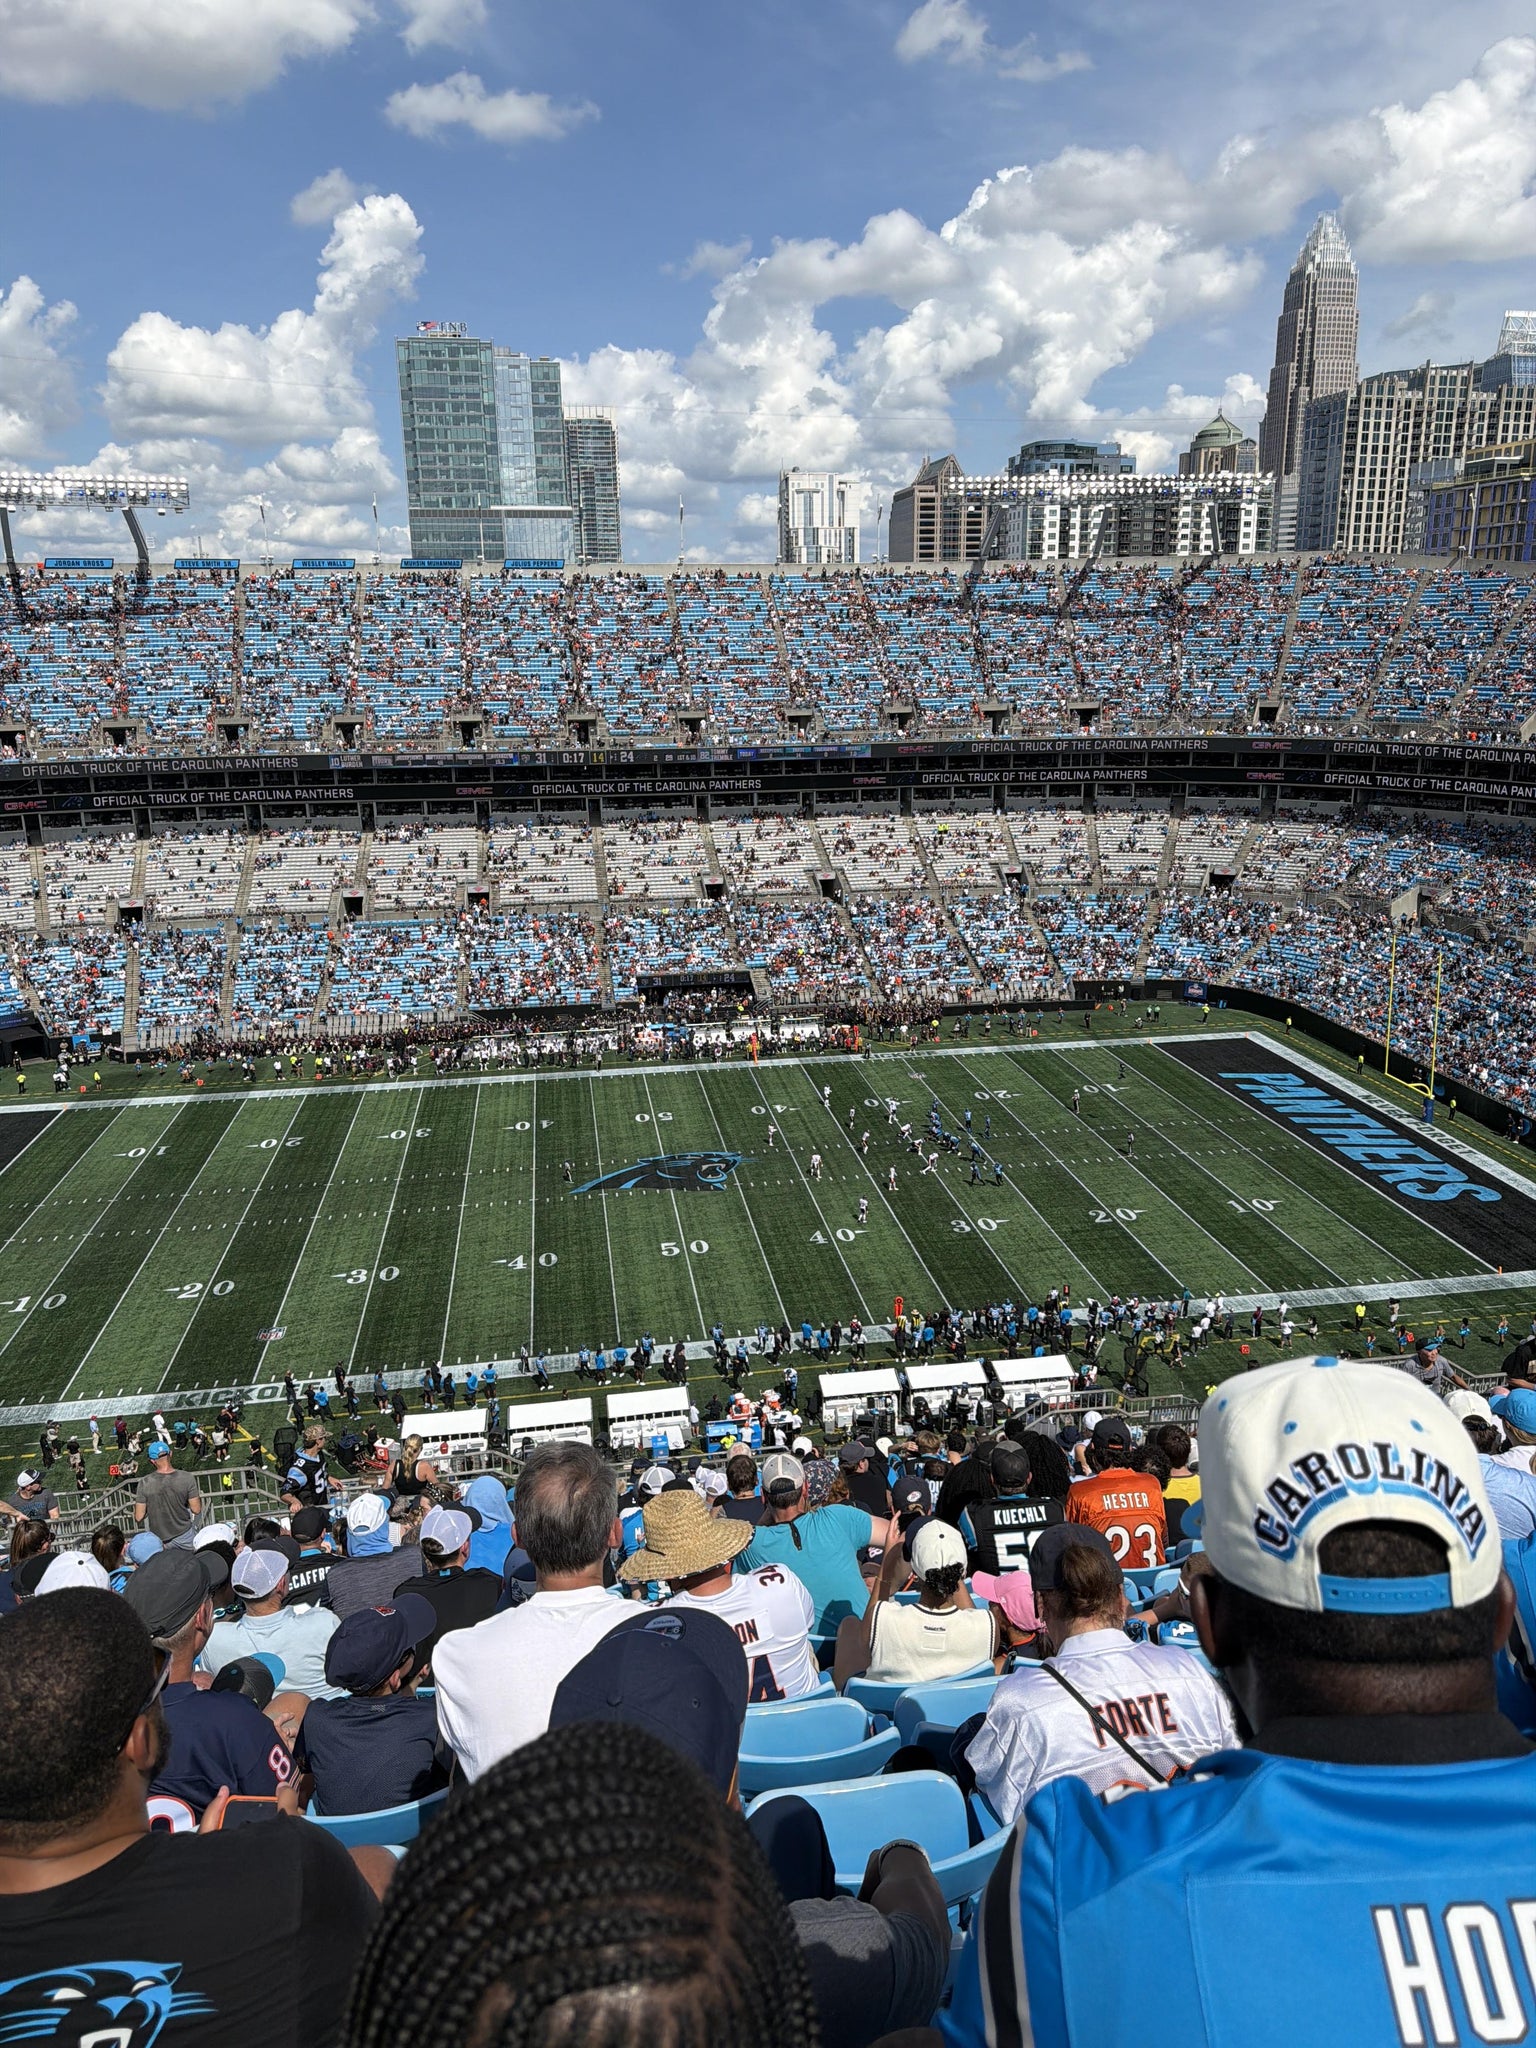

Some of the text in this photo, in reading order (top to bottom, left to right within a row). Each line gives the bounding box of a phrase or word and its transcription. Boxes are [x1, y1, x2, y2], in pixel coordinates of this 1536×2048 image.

[971, 739, 1208, 752] OFFICIAL TRUCK OF THE CAROLINA PANTHERS
[1333, 742, 1382, 754] OFFICIAL
[1386, 744, 1422, 756] TRUCK
[1424, 746, 1440, 757] OF
[1442, 747, 1462, 758] THE
[1465, 748, 1521, 763] CAROLINA
[535, 753, 547, 764] 31
[562, 752, 585, 763] 0:17
[593, 752, 605, 763] 14
[620, 751, 635, 763] 24
[22, 758, 298, 776] OFFICIAL TRUCK OF THE CAROLINA PANTHERS
[922, 769, 1148, 784] OFFICIAL TRUCK OF THE CAROLINA PANTHERS
[1324, 773, 1373, 785] OFFICIAL
[1376, 775, 1410, 787] TRUCK
[1413, 777, 1427, 788] OF
[1429, 779, 1451, 790] THE
[1454, 781, 1508, 795] CAROLINA
[532, 779, 762, 794] OFFICIAL TRUCK OF THE CAROLINA PANTHERS
[93, 788, 354, 807] OFFICIAL TRUCK OF THE CAROLINA PANTHERS
[724, 973, 735, 982] 24
[1357, 1094, 1478, 1155] NEVER FORGET
[1217, 1072, 1502, 1202] PANTHERS
[260, 1331, 282, 1340] NFL
[111, 1465, 119, 1474] 20
[1102, 1492, 1149, 1510] HESTER
[1253, 1447, 1488, 1566] CAROLINA
[993, 1505, 1047, 1525] KUECHLY
[1104, 1523, 1158, 1568] 23
[1089, 1692, 1178, 1748] FORTE
[268, 1743, 291, 1783] 8
